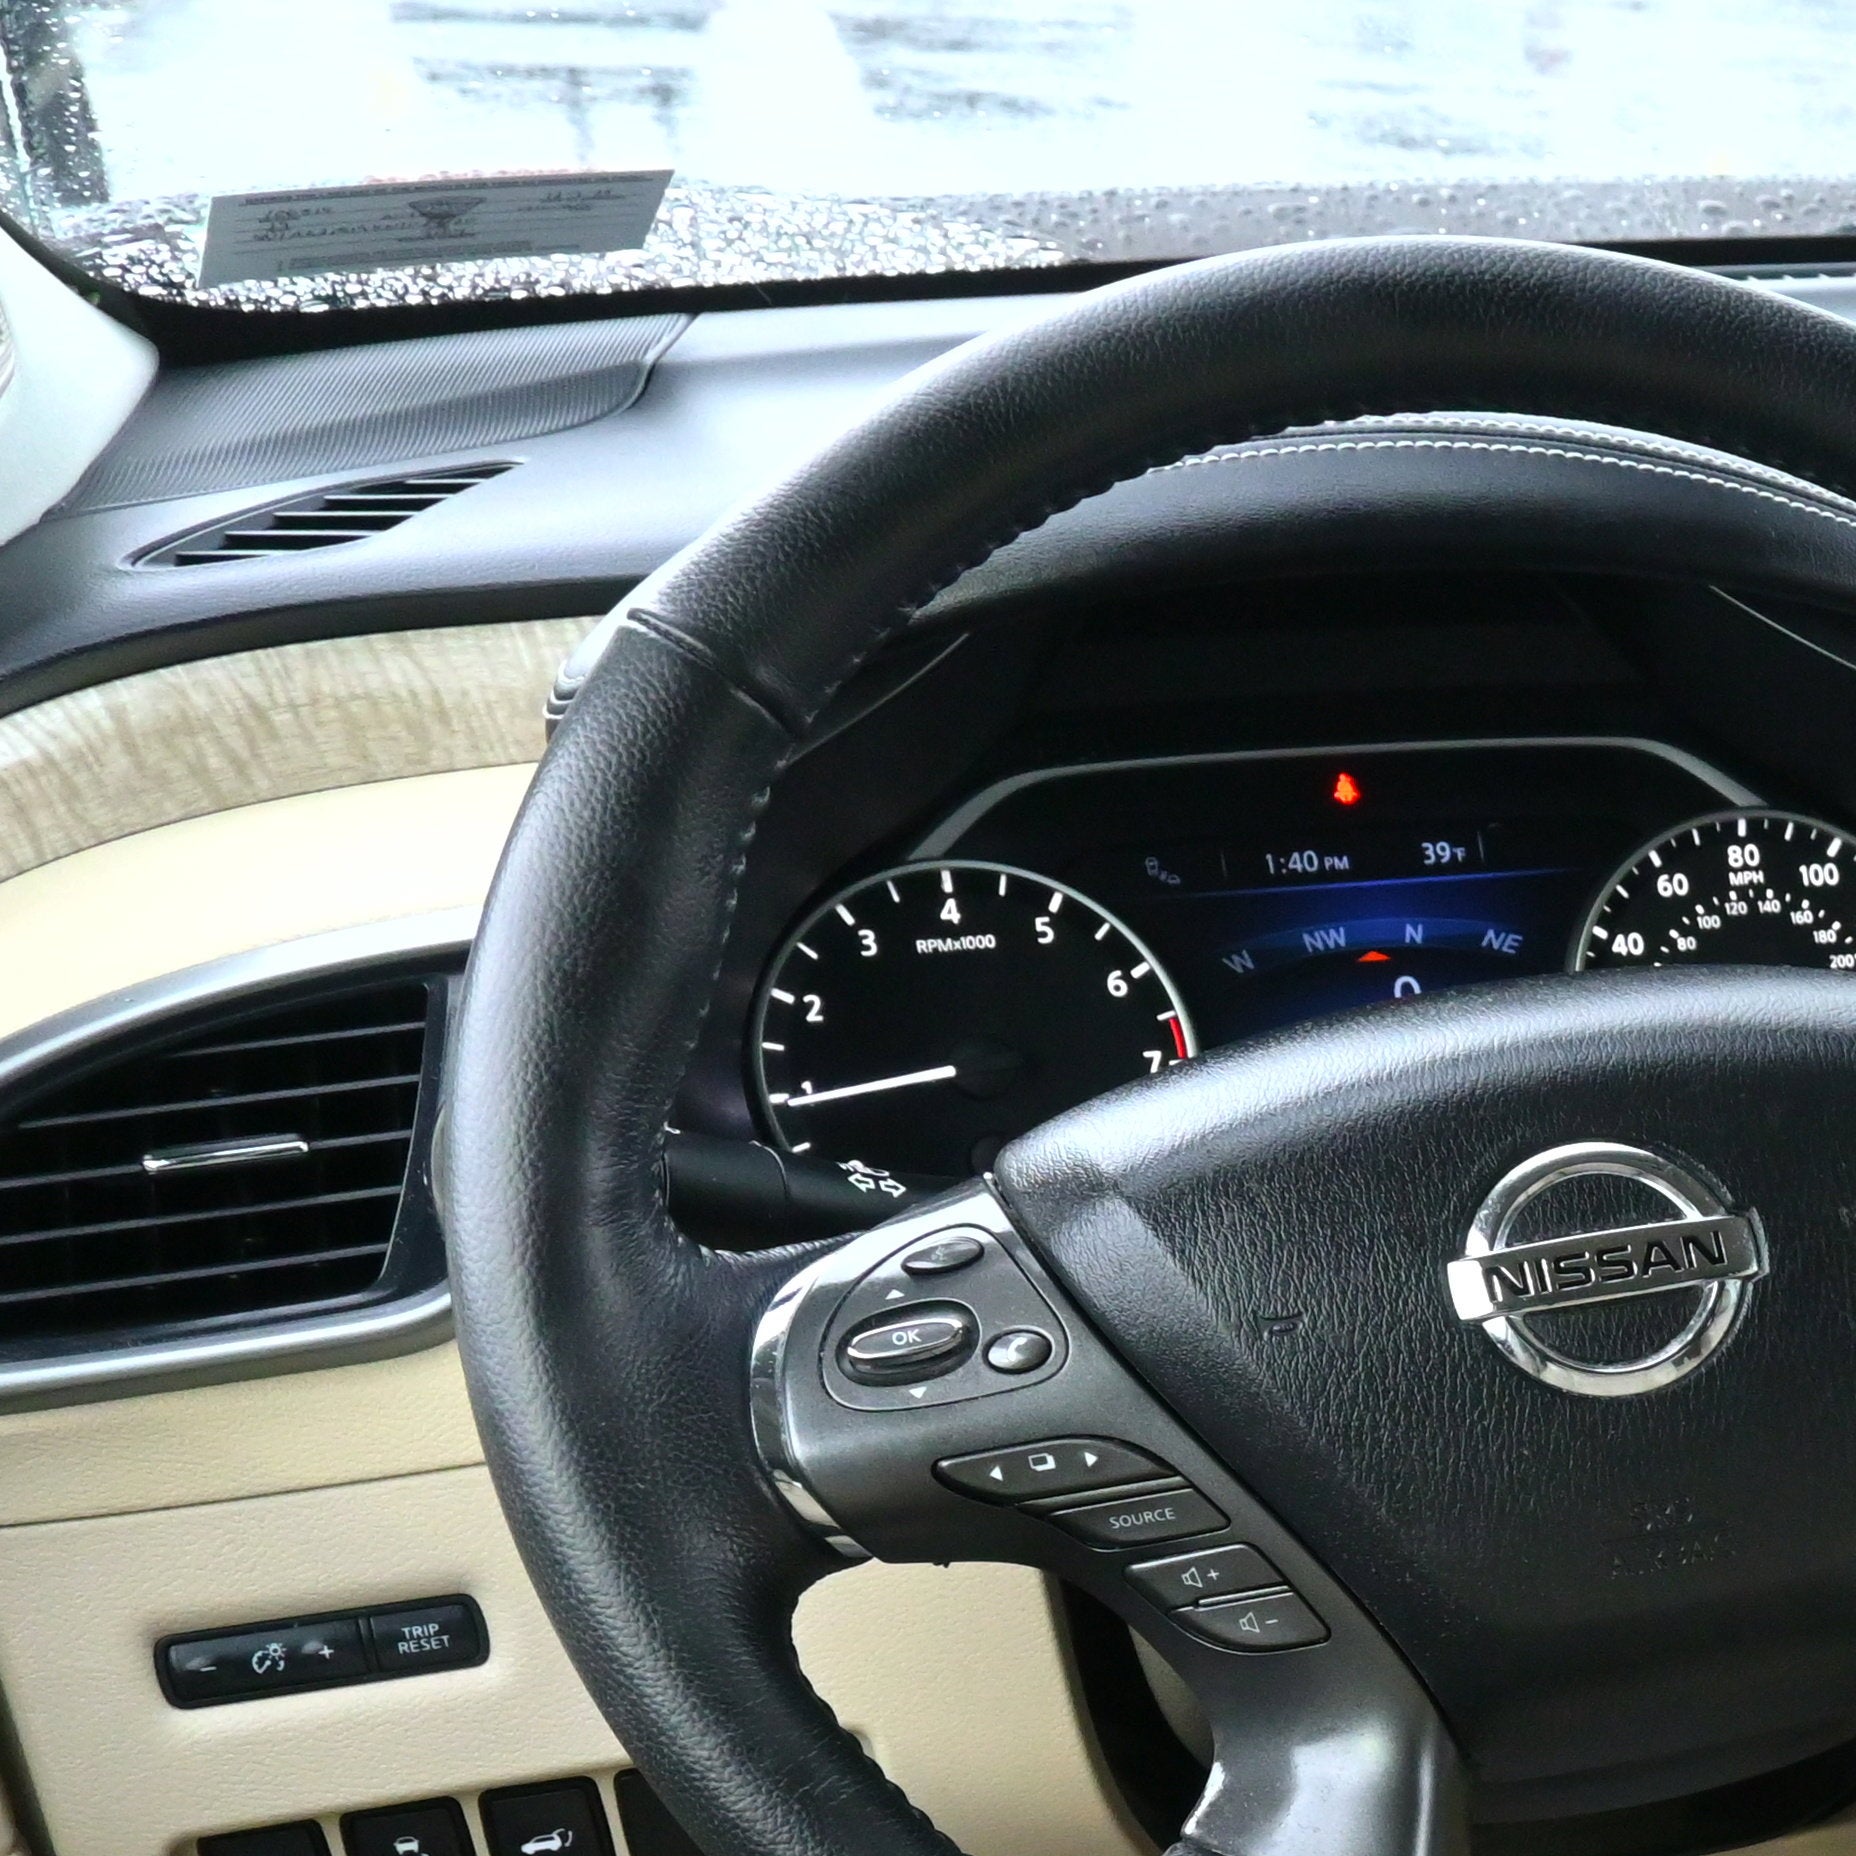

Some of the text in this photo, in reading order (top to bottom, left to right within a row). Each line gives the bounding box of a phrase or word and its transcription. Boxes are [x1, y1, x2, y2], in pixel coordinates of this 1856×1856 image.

[1265, 849, 1350, 875] 1:40 PM
[1727, 843, 1760, 868] 80
[1657, 873, 1689, 897] 60
[1729, 870, 1765, 886] MPH
[1799, 862, 1839, 887] 100
[940, 898, 961, 925] 4
[1724, 901, 1748, 916] 120
[1757, 899, 1781, 914] 140
[1790, 909, 1814, 924] 160
[1034, 916, 1055, 945] 5
[1405, 924, 1424, 944] N
[1696, 915, 1721, 930] 100
[858, 929, 878, 957] 3
[916, 934, 996, 955] RPMx1000
[1302, 927, 1348, 953] NW
[1481, 929, 1523, 954] NE
[1611, 932, 1644, 957] 40
[1677, 936, 1696, 951] 80
[1813, 929, 1837, 944] 180
[1222, 949, 1255, 974] W
[1830, 953, 1855, 969] 200
[1106, 970, 1128, 998] 6
[802, 994, 824, 1022] 2
[1142, 1050, 1163, 1074] 7
[1484, 1230, 1729, 1303] NISSAN
[892, 1329, 922, 1345] OK
[1109, 1506, 1176, 1529] SOURCE
[401, 1623, 439, 1640] TRIP
[398, 1635, 450, 1654] RESET
